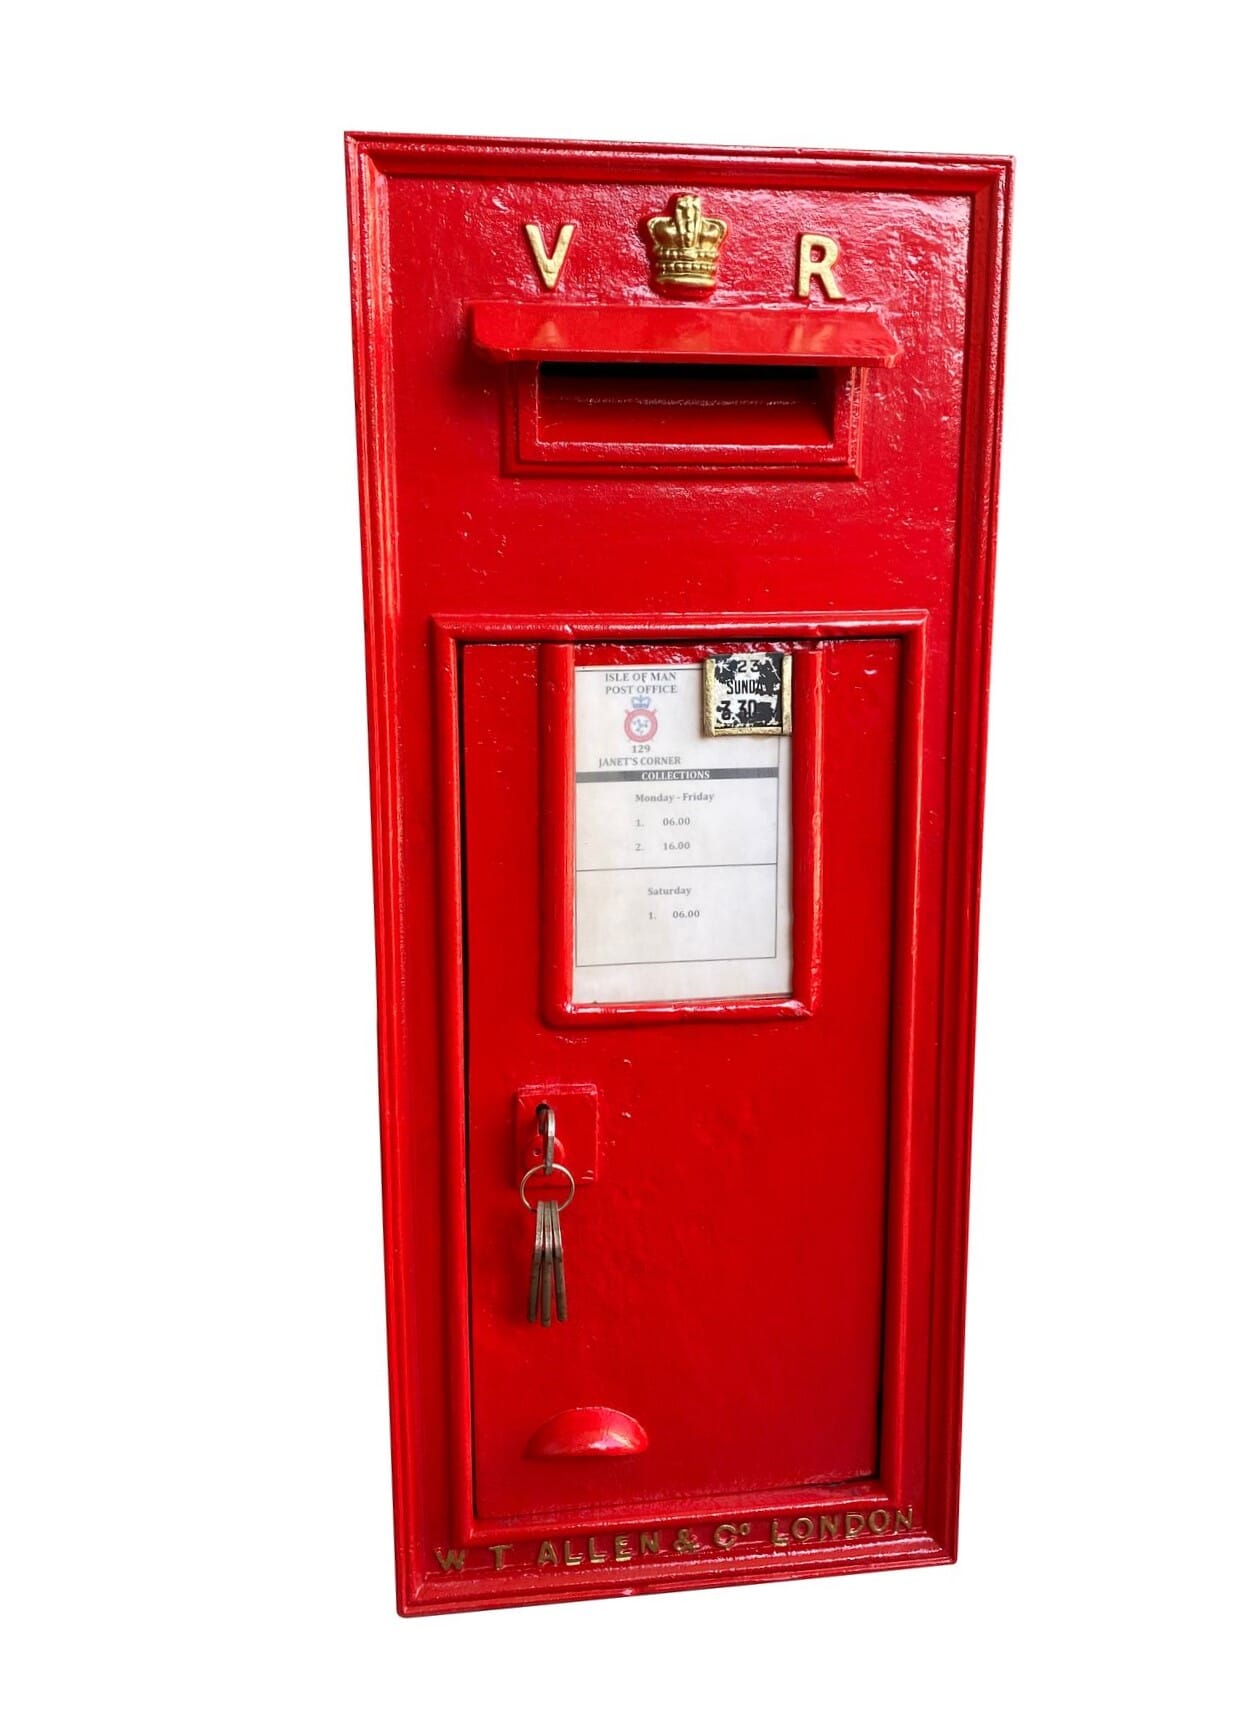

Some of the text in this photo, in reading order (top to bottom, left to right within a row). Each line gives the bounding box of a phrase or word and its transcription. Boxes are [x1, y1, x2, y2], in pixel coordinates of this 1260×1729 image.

[524, 223, 846, 300] V R
[737, 659, 761, 673] 23
[605, 672, 677, 682] ISLE OF MAN
[605, 684, 678, 695] POST OFFICE
[632, 744, 651, 754] 129
[598, 756, 681, 768] JANET'S CORNER
[641, 770, 711, 781] COLLECTIONS
[635, 793, 675, 804] Monday
[682, 792, 715, 802] Friday
[635, 817, 691, 827] 1. 06.00
[635, 841, 691, 852] 2. 16.00
[647, 886, 692, 897] Saturday
[648, 909, 700, 920] 1. 06.00
[434, 1547, 466, 1571] W
[489, 1543, 514, 1571] T
[537, 1531, 660, 1567] ALLEN
[673, 1528, 700, 1554] &
[771, 1506, 914, 1547] LONDON
